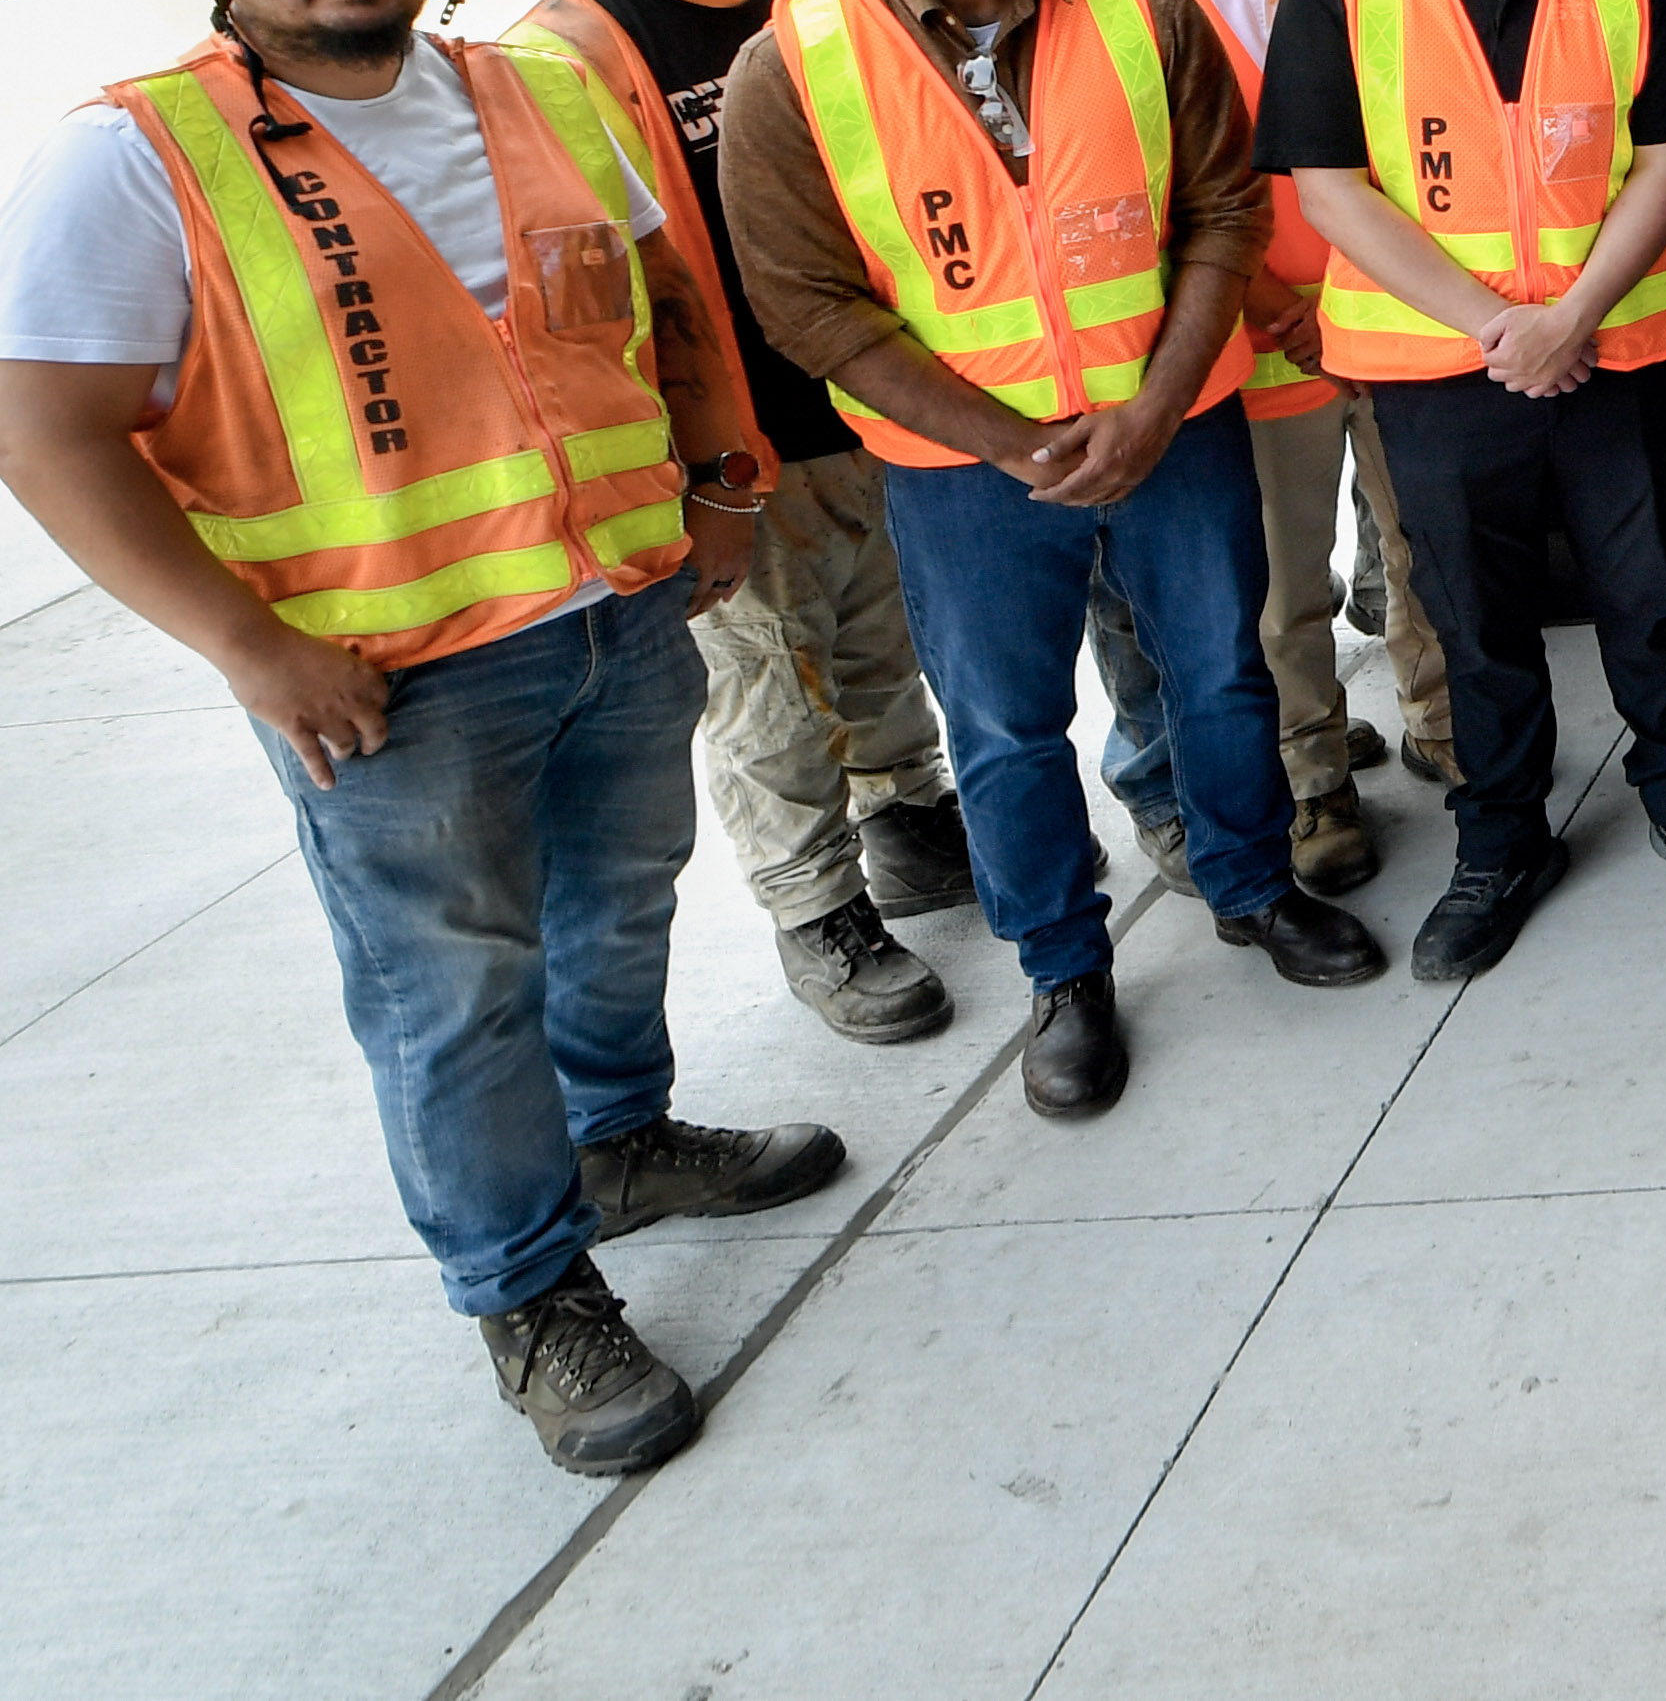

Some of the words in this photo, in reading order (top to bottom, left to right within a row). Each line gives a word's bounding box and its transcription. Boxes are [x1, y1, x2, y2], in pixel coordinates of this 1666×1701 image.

[1420, 117, 1453, 213] PMC
[921, 189, 976, 290] PMC
[296, 170, 409, 455] CONTRACTOR
